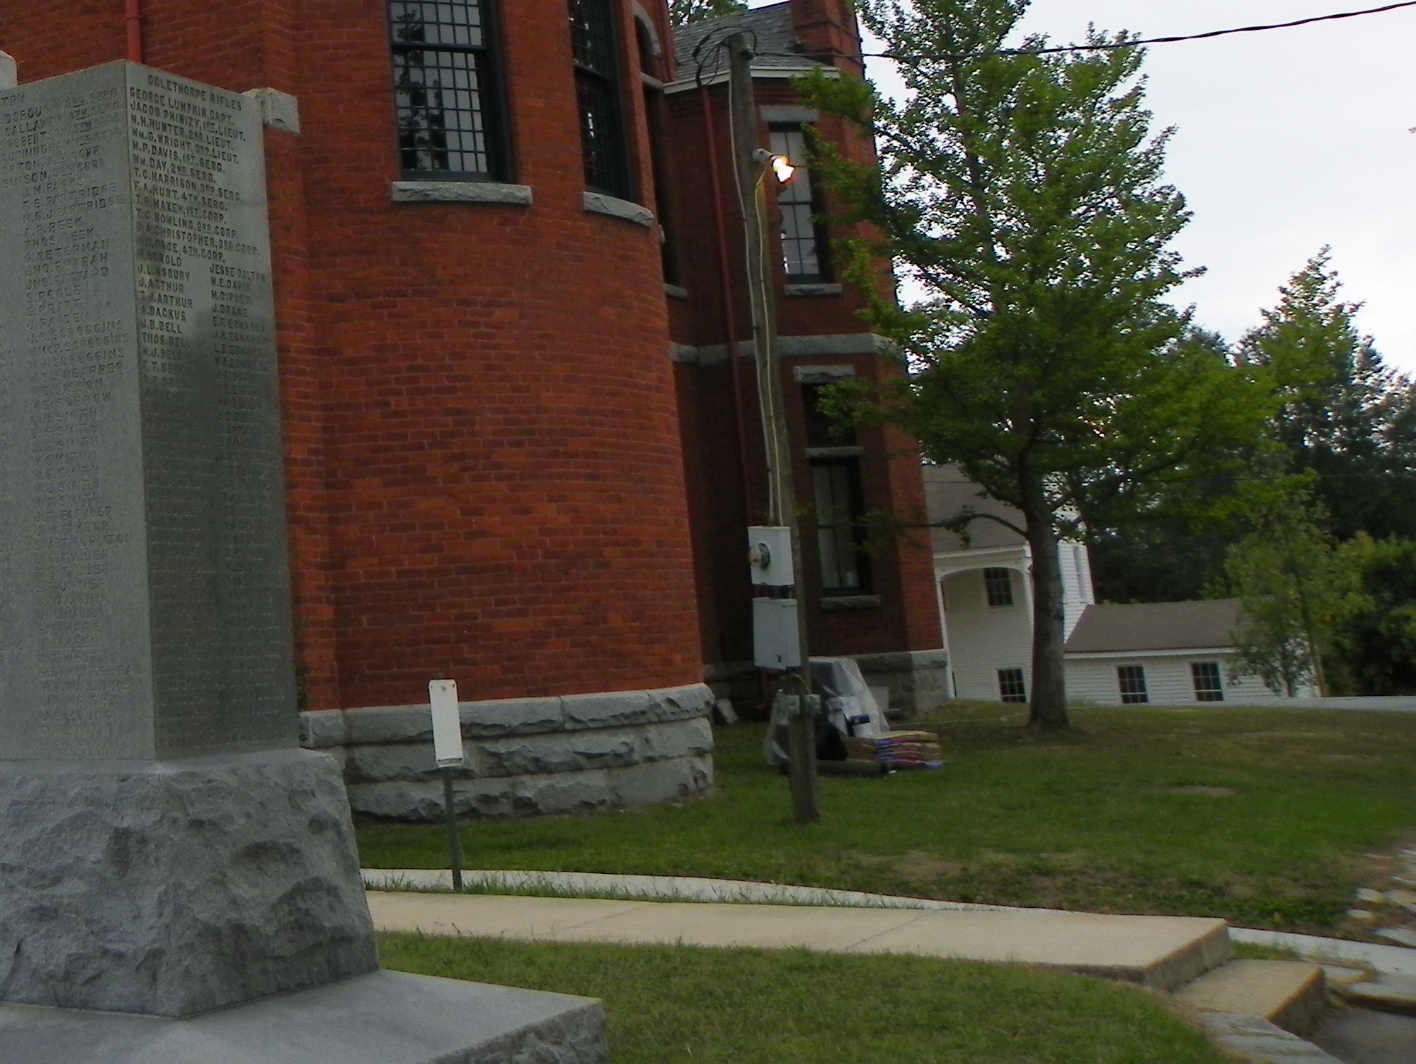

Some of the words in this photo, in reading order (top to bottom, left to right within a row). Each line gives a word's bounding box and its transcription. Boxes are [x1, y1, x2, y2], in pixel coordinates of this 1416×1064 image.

[130, 86, 165, 107] GEORGE
[148, 74, 206, 102] OGLETHORPE
[210, 93, 242, 111] RIFLES
[130, 101, 160, 118] JACOB
[209, 263, 235, 277] JESSE
[237, 269, 266, 283] DALTON
